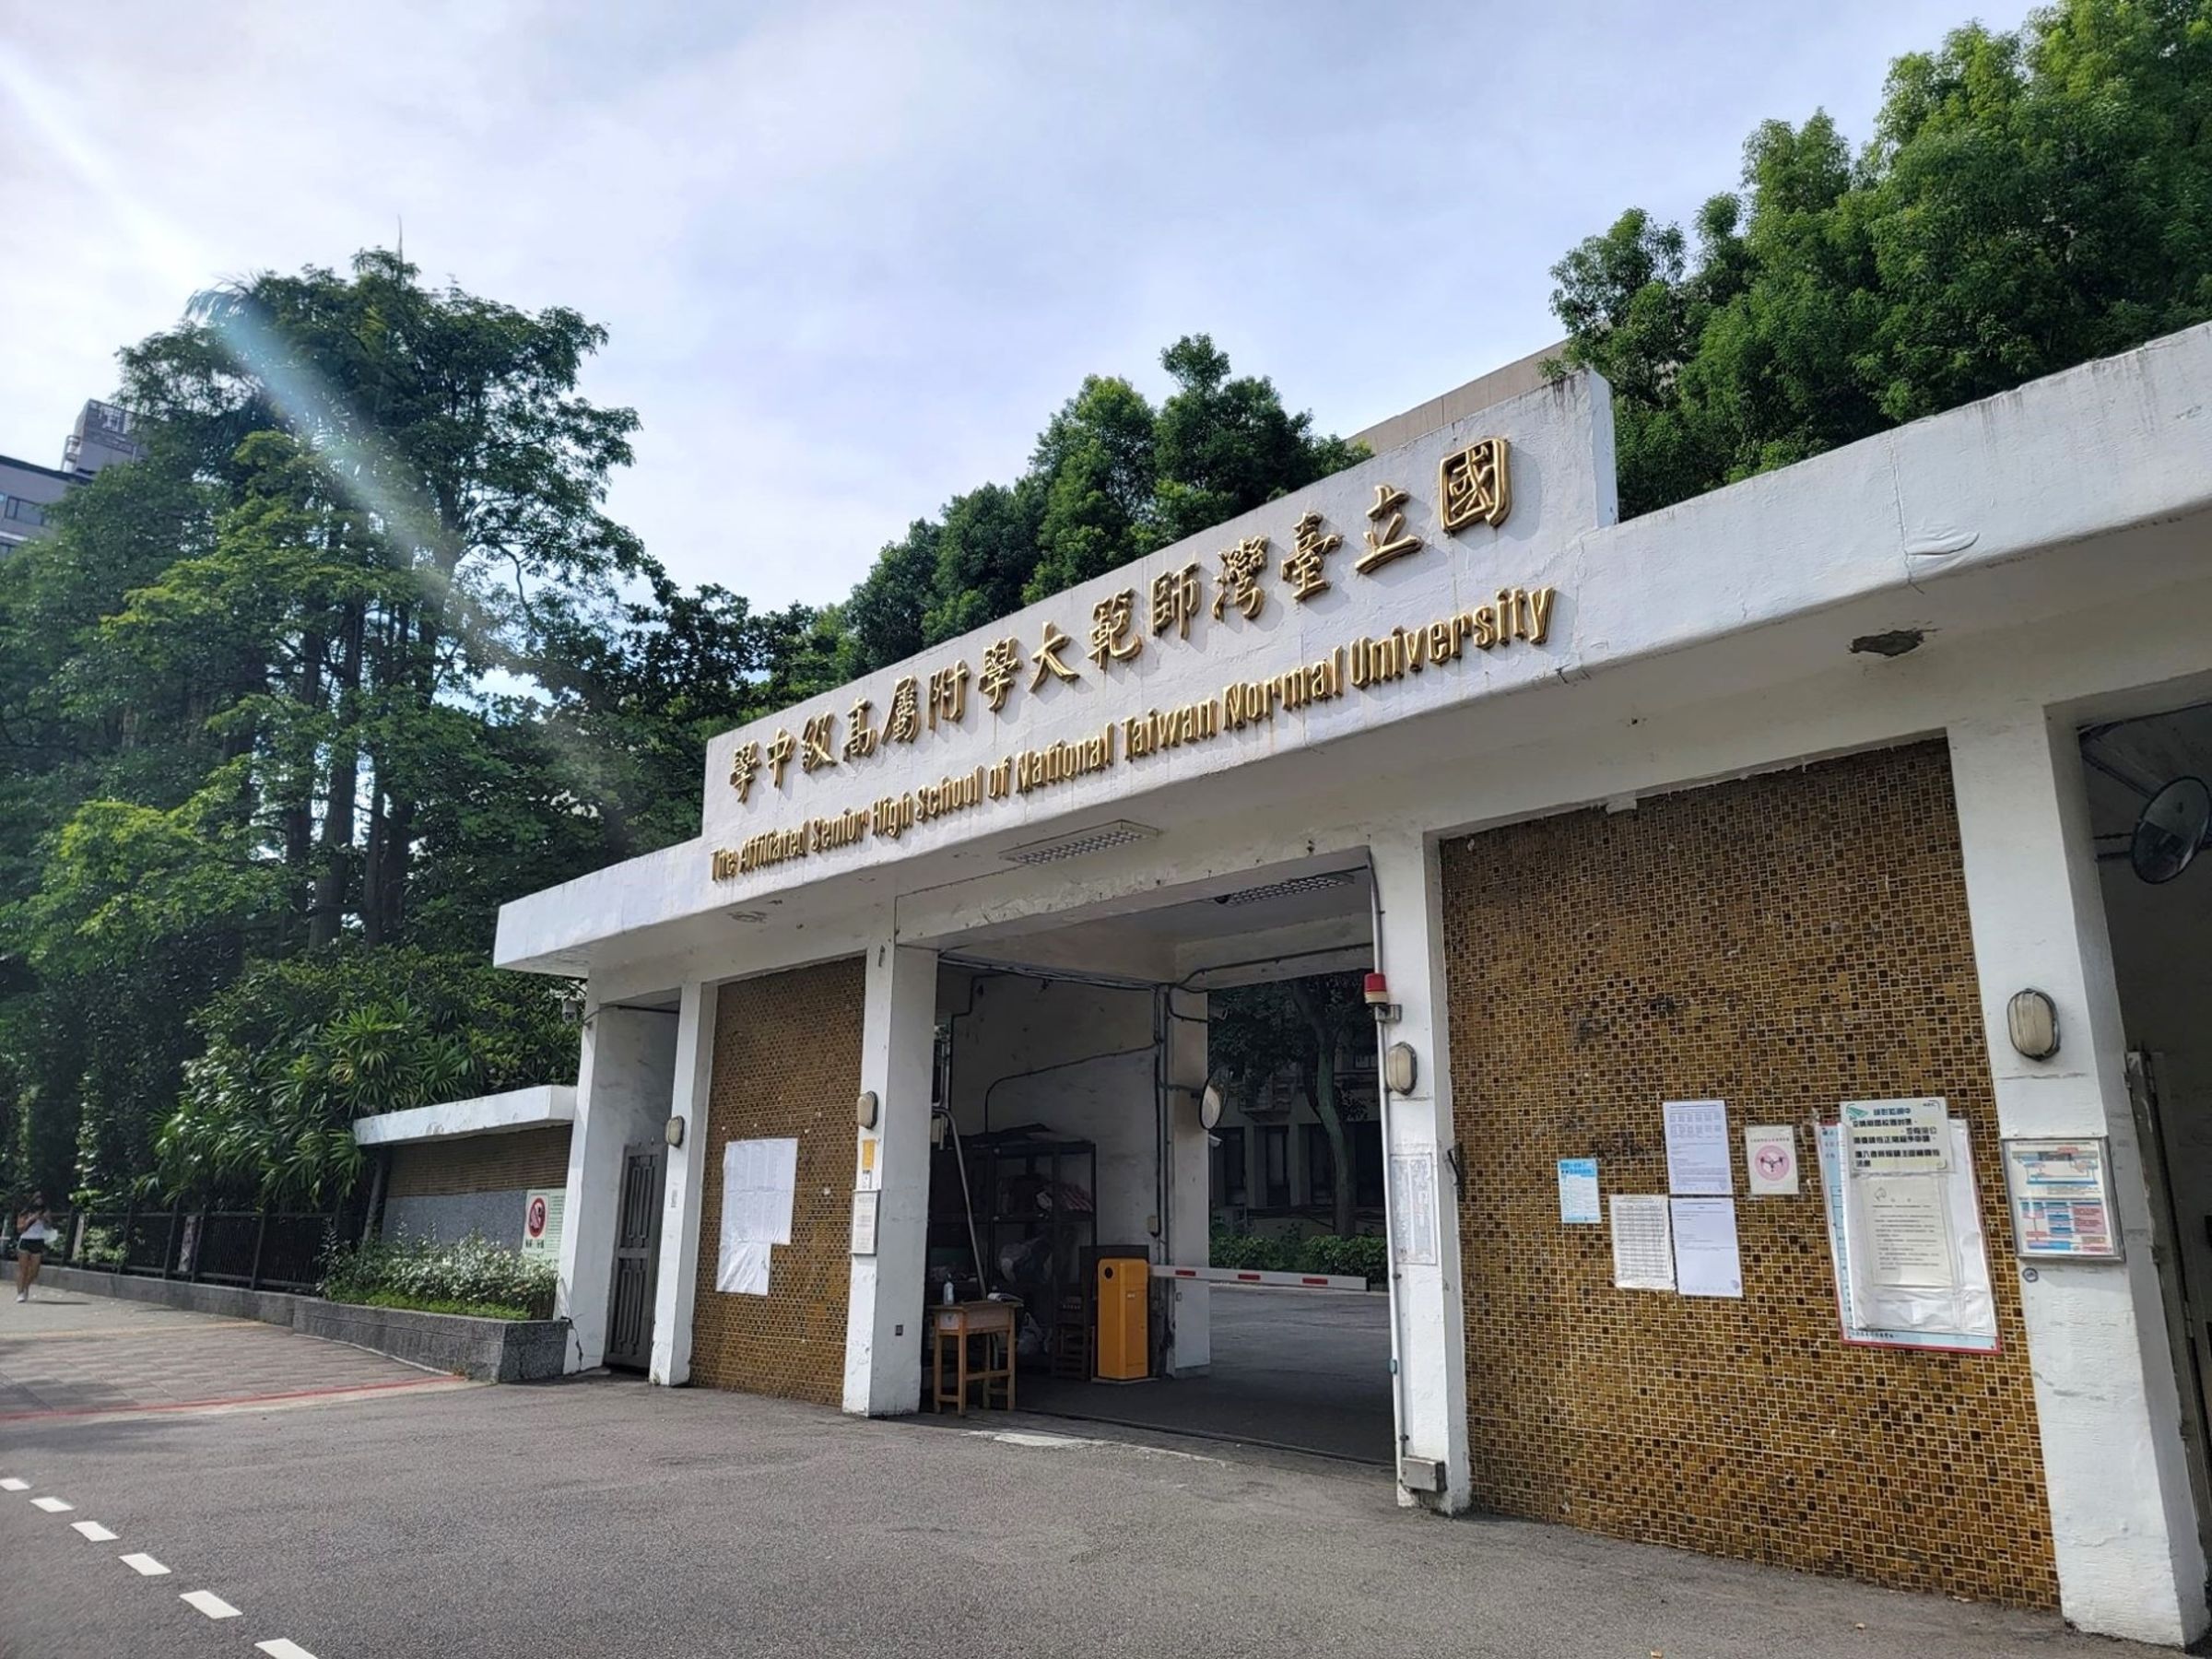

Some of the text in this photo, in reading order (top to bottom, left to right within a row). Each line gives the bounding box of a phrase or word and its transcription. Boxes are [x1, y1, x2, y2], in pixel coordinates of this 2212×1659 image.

[711, 586, 1555, 883] The Affiliated Senior High School of National Taiwan Normal University
